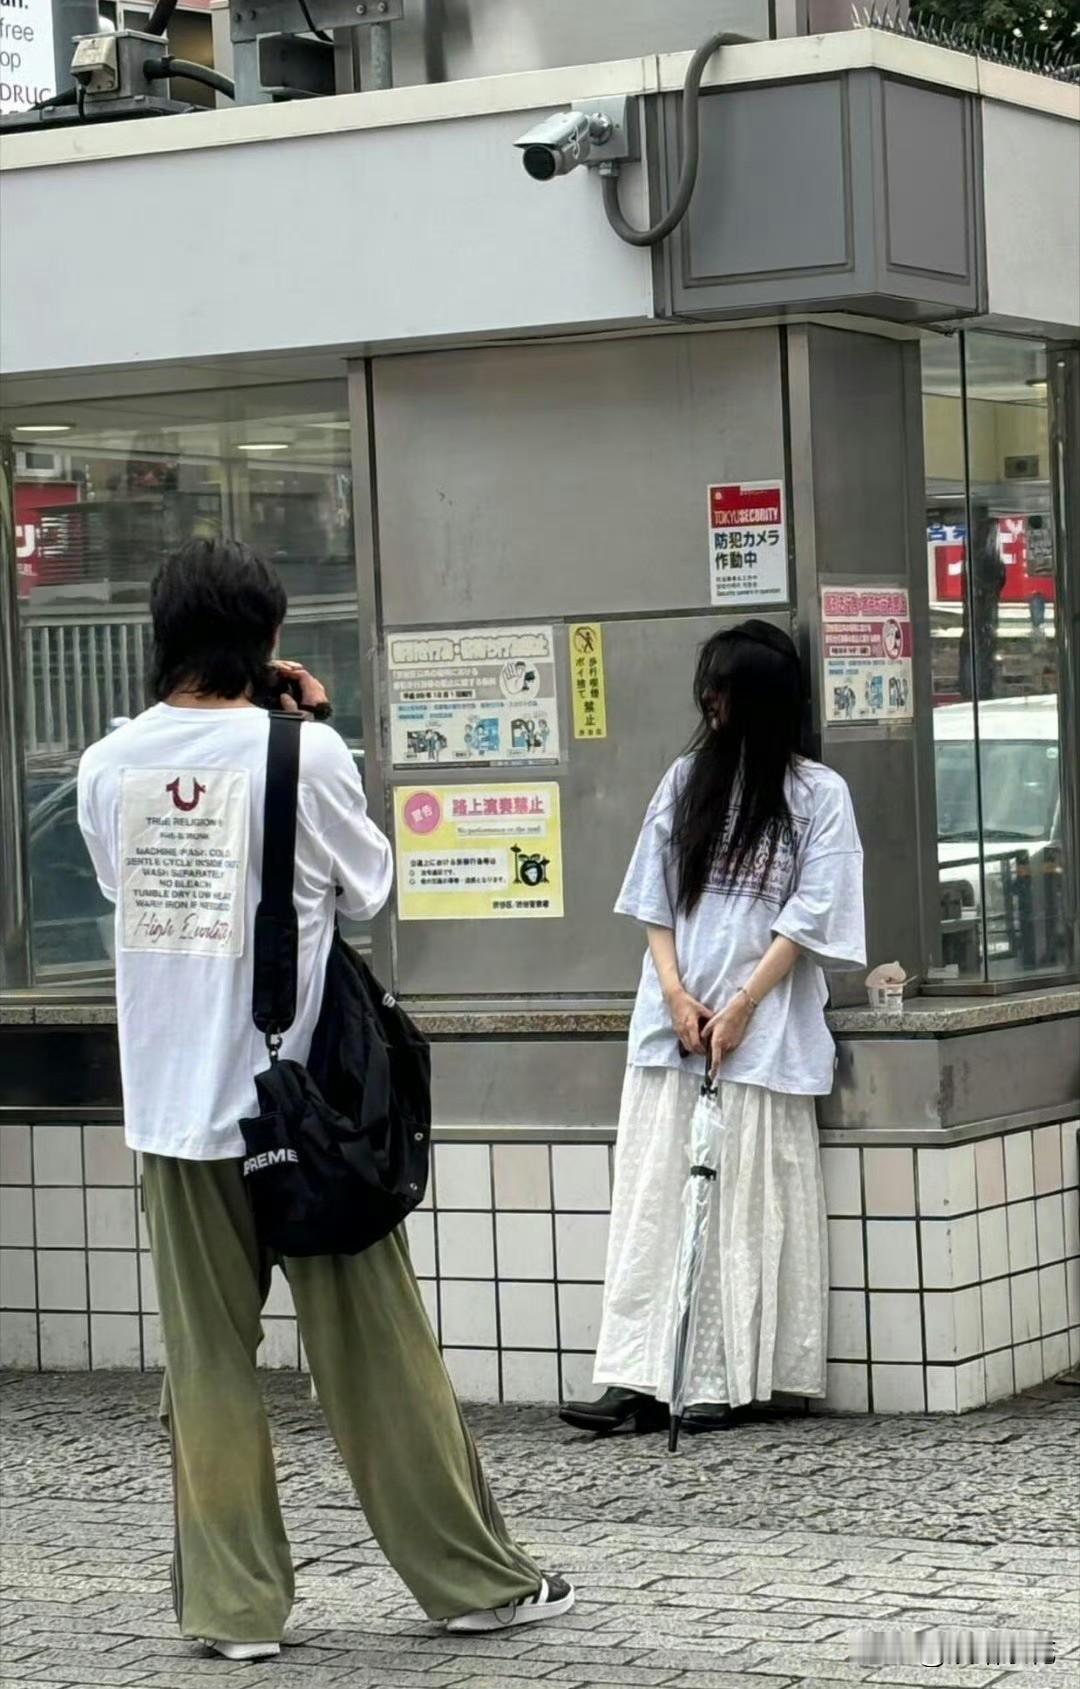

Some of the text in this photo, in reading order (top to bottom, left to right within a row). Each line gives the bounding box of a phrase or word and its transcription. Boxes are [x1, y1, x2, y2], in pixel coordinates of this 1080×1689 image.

[714, 530, 780, 550] 防犯カメラ
[715, 551, 757, 570] 作動中
[452, 796, 545, 817] 路上演奏禁止
[133, 911, 176, 943] High
